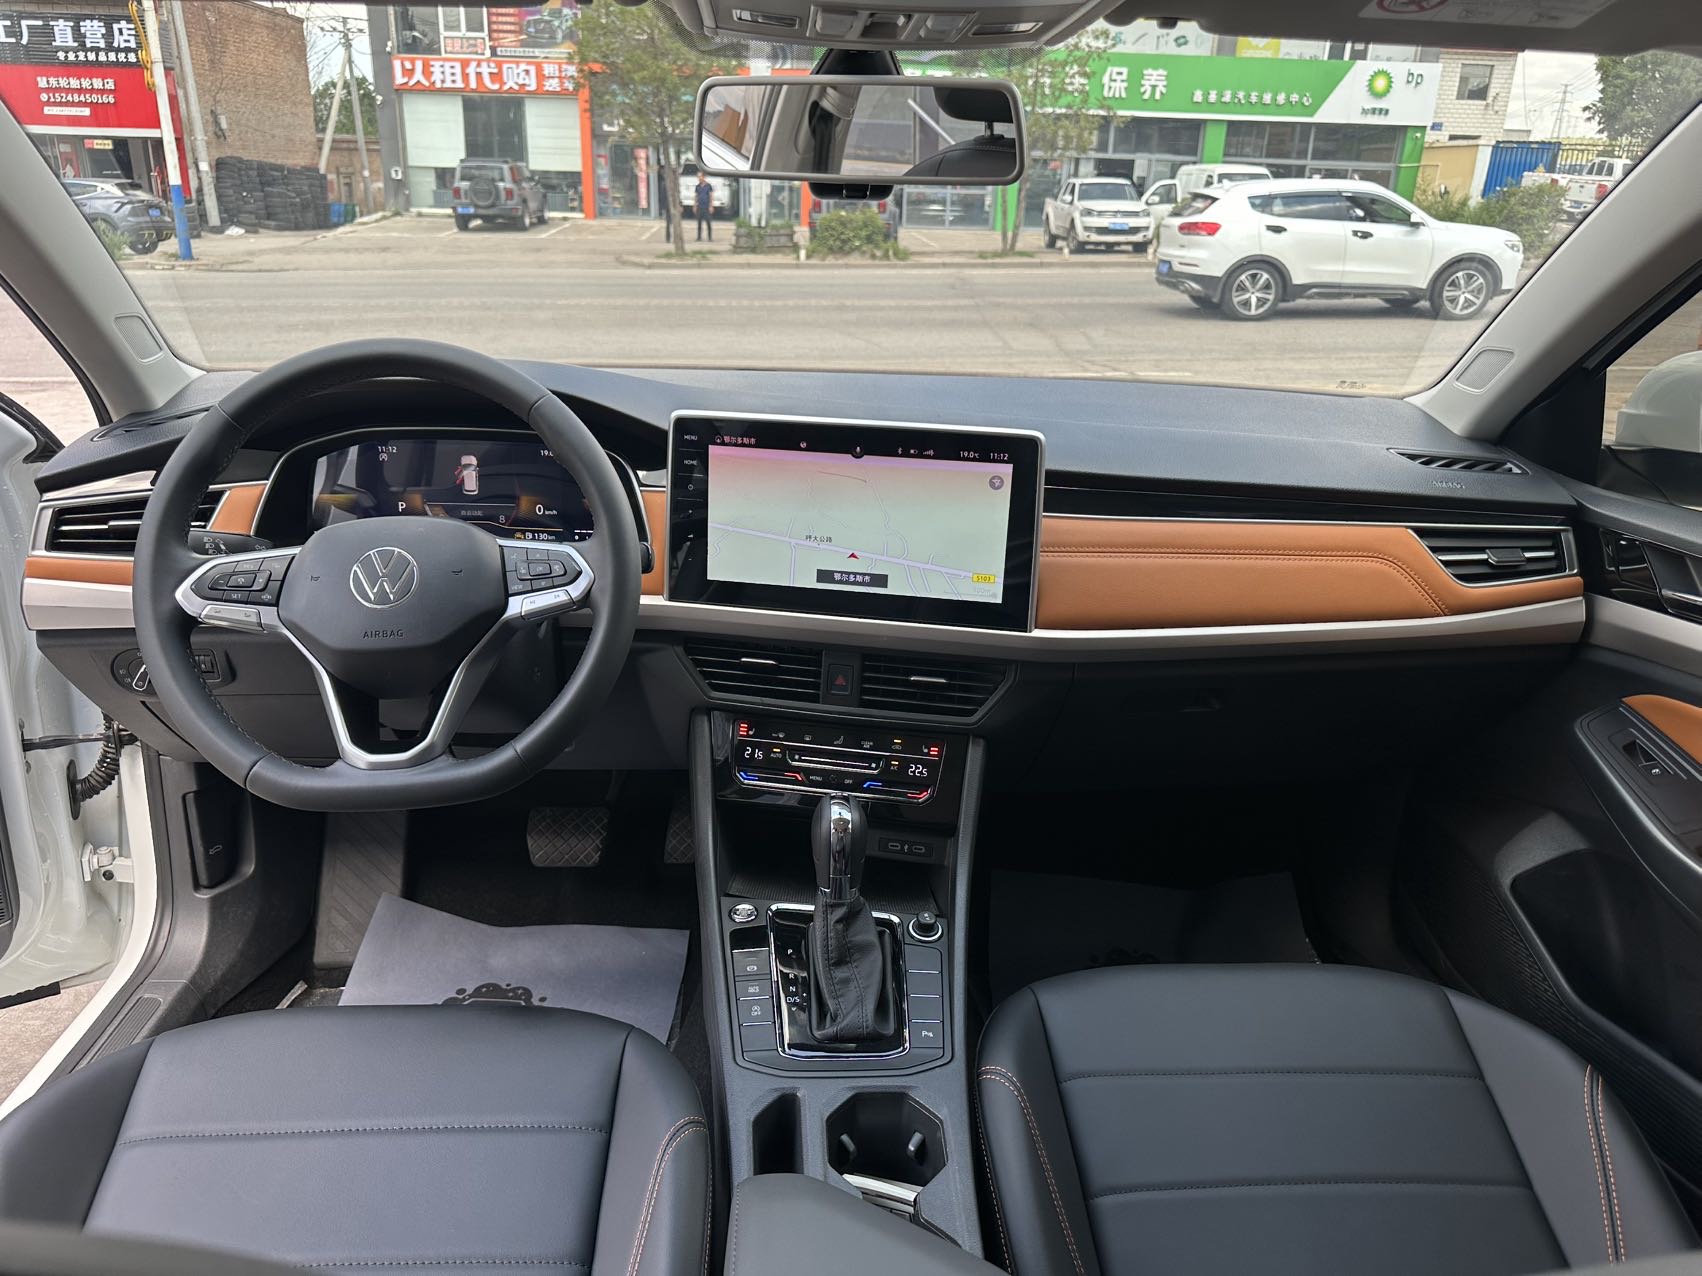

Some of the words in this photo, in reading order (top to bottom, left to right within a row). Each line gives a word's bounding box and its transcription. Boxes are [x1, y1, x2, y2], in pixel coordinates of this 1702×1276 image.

[0, 19, 136, 48] 工厂直营店
[392, 59, 538, 91] 以租代购
[1406, 68, 1424, 88] bp
[49, 93, 115, 103] 15248450166
[723, 435, 757, 445] 鄂尔多斯市
[990, 452, 1009, 460] 11:12
[398, 501, 406, 512] P
[535, 504, 544, 515] 0
[833, 573, 871, 583] 鄂尔多斯市
[363, 629, 404, 639] AIRBAG
[744, 746, 764, 760] 21.5
[908, 764, 928, 776] 22.5
